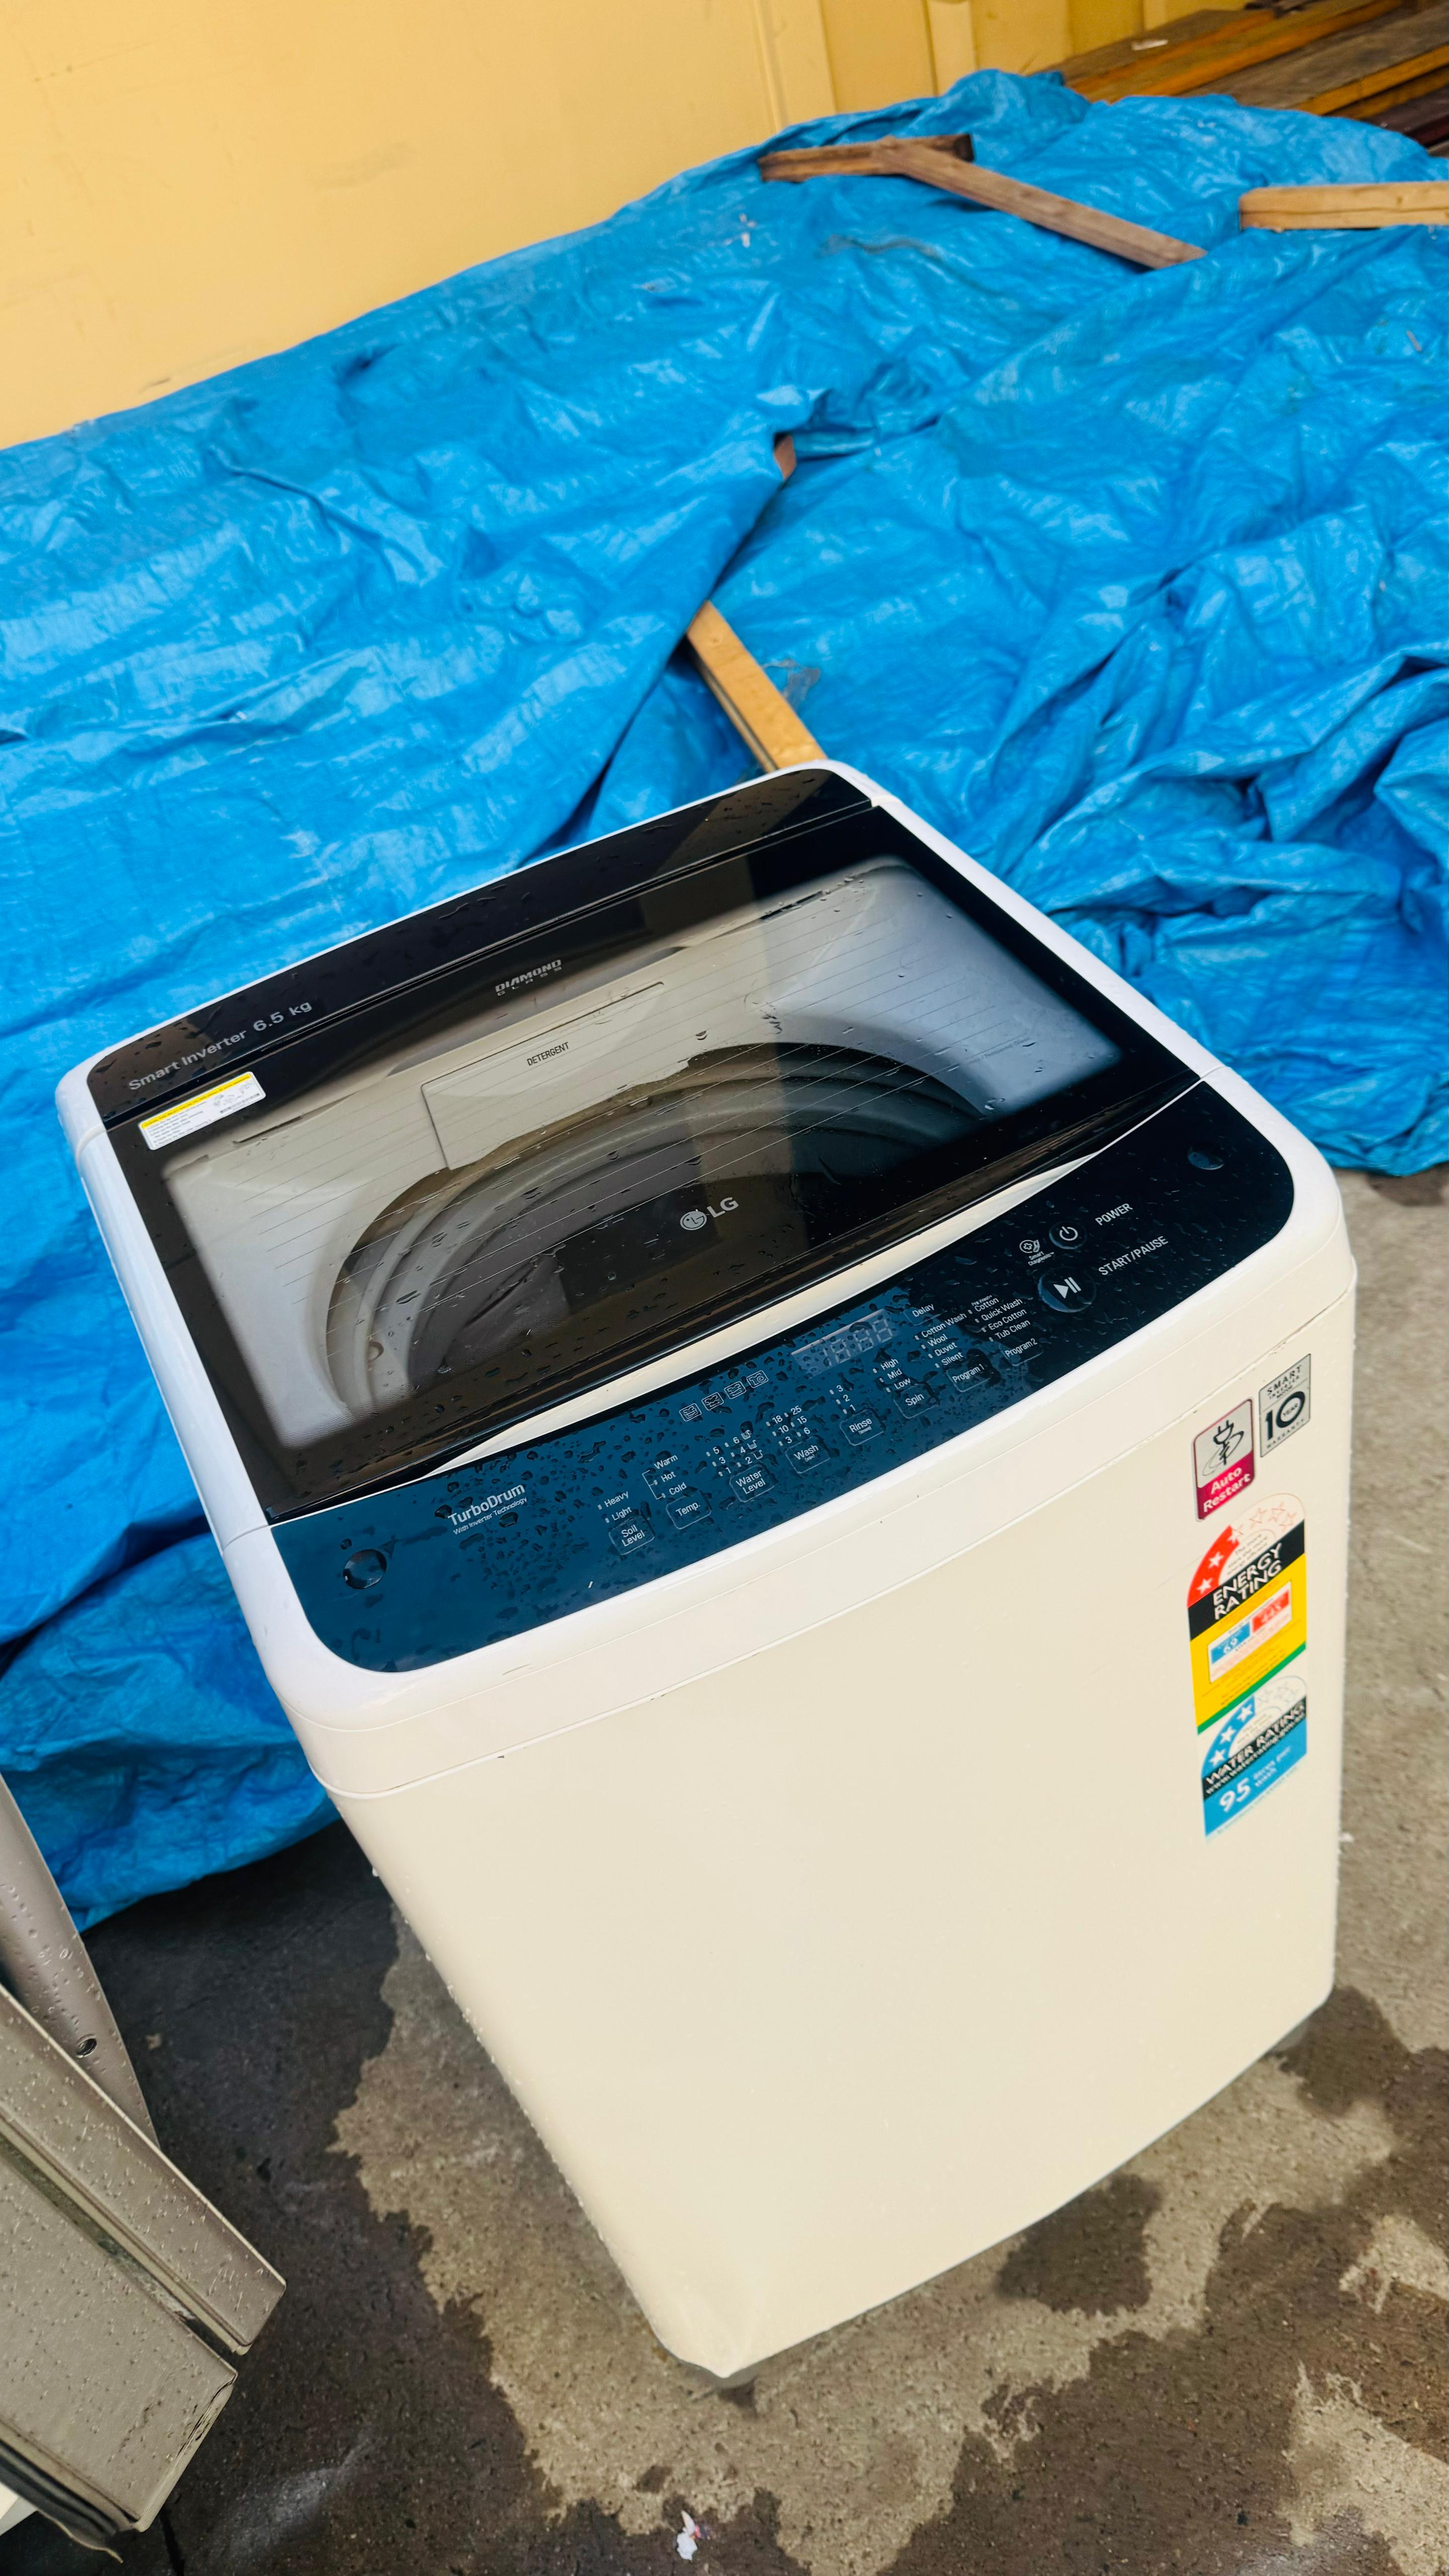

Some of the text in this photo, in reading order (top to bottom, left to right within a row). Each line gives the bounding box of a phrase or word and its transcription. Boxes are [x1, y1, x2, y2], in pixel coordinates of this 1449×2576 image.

[495, 959, 561, 992] DIAMOND
[129, 1002, 312, 1090] Smart Inverter 6.5 kg
[527, 1041, 569, 1066] DETERGENT
[707, 1197, 739, 1218] LG
[1095, 1203, 1133, 1225] POWER
[1098, 1236, 1168, 1275] START/PAUSE
[912, 1303, 934, 1318] Delay
[974, 1297, 999, 1312] Cotton
[981, 1298, 1023, 1321] Quick Wash
[921, 1312, 967, 1338] Cotton Wash
[988, 1308, 1027, 1331] Eco Cotton
[994, 1319, 1031, 1339] Tub Clean
[927, 1334, 948, 1347] Wool
[934, 1342, 958, 1357] Duvet
[880, 1358, 899, 1371] High
[941, 1351, 964, 1367] Silent
[887, 1369, 902, 1380] Mid
[952, 1367, 980, 1384] Program
[1267, 1364, 1302, 1396] SMART
[894, 1378, 911, 1390] Low
[905, 1393, 925, 1406] Spin
[772, 1405, 802, 1424] 18 25
[1265, 1391, 1306, 1441] 10
[778, 1416, 807, 1434] 10 15
[849, 1418, 872, 1433] Rinse
[713, 1446, 719, 1455] 5
[793, 1444, 819, 1460] Wash
[654, 1455, 678, 1469] Warm
[661, 1471, 676, 1483] Hot
[736, 1470, 762, 1487] Water
[1211, 1467, 1242, 1495] Auto
[669, 1482, 687, 1495] Cold
[743, 1478, 766, 1495] Level
[1203, 1473, 1251, 1512] Restart
[447, 1484, 525, 1525] TurboDrum
[604, 1491, 629, 1507] Heavy
[468, 1513, 493, 1528] Inverter
[493, 1497, 527, 1516] Technology
[611, 1507, 632, 1521] Light
[675, 1501, 701, 1516] Temp.
[621, 1524, 638, 1538] Soil
[622, 1530, 646, 1547] Level
[1213, 1543, 1282, 1606] ENERGY
[1215, 1560, 1281, 1620] RATING
[1205, 1745, 1254, 1785] WATER
[1256, 1702, 1305, 1748] RATING
[1220, 1778, 1251, 1812] 95
